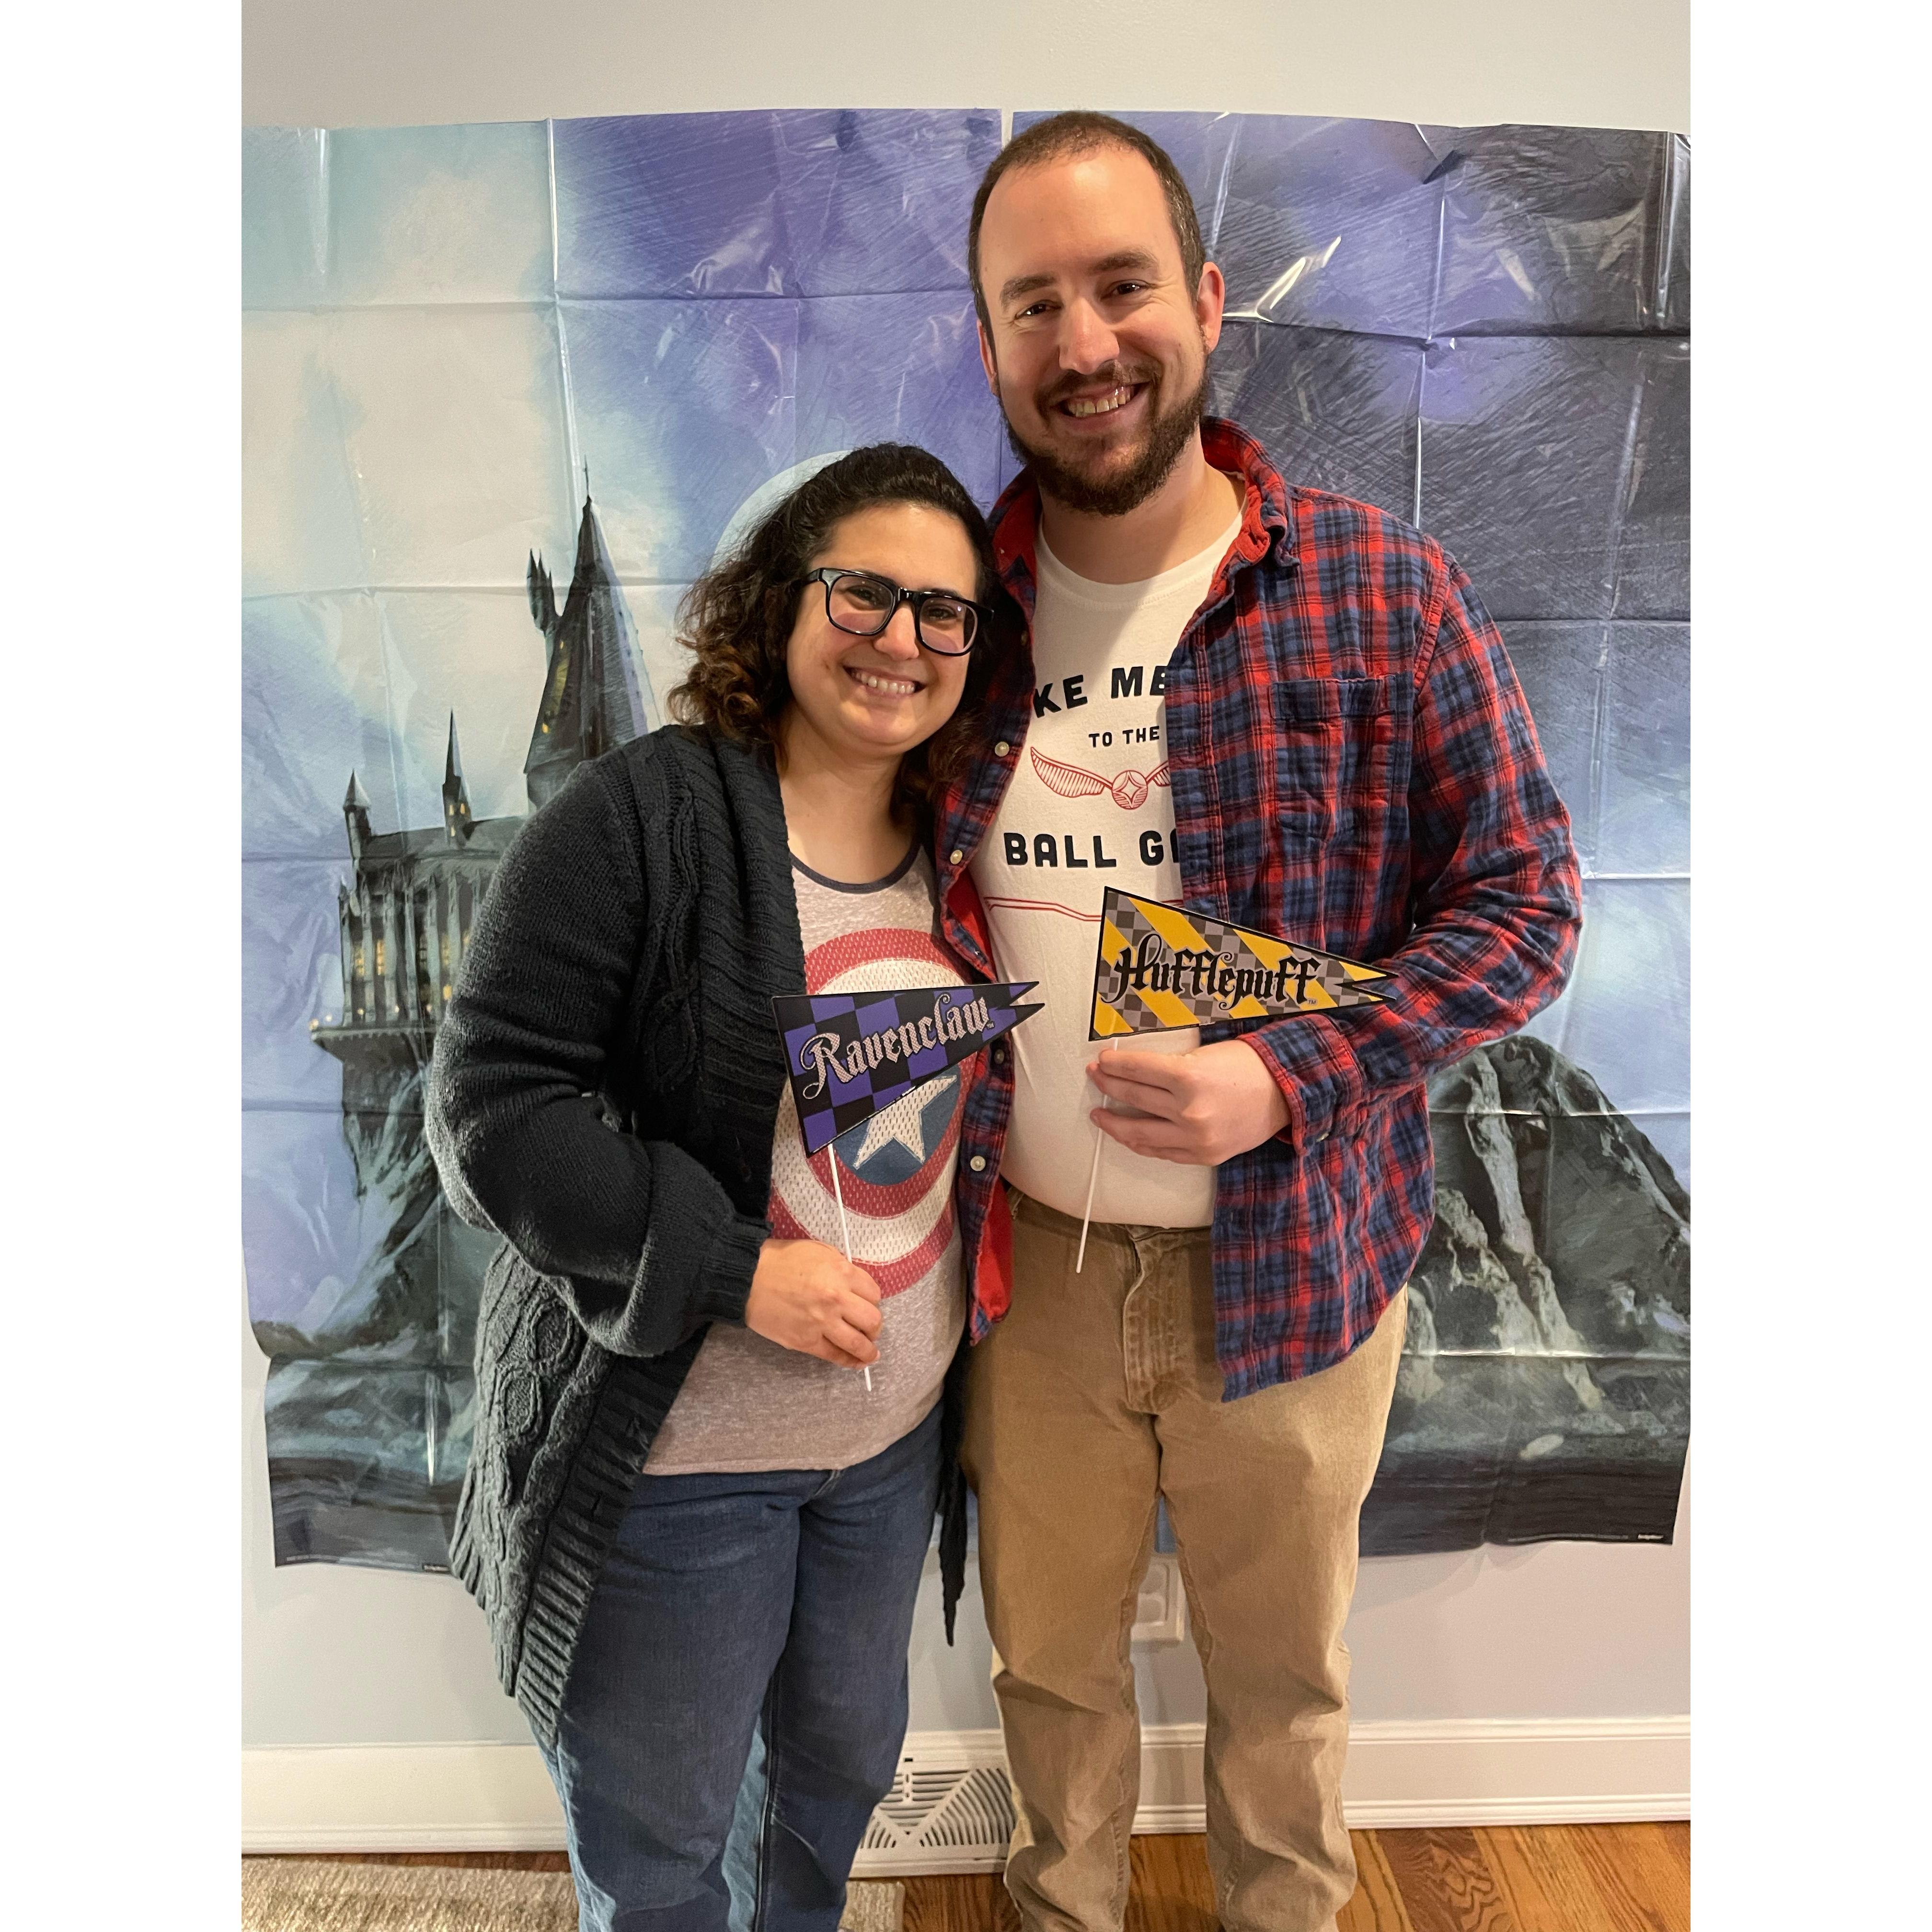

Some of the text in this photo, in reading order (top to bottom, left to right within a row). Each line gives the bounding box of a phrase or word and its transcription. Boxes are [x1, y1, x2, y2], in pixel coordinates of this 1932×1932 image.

[1089, 725, 1160, 748] TO THE
[1004, 829, 1180, 868] BALL G
[1101, 933, 1321, 1011] Hufflepuff
[800, 992, 990, 1099] Ravenclaw
